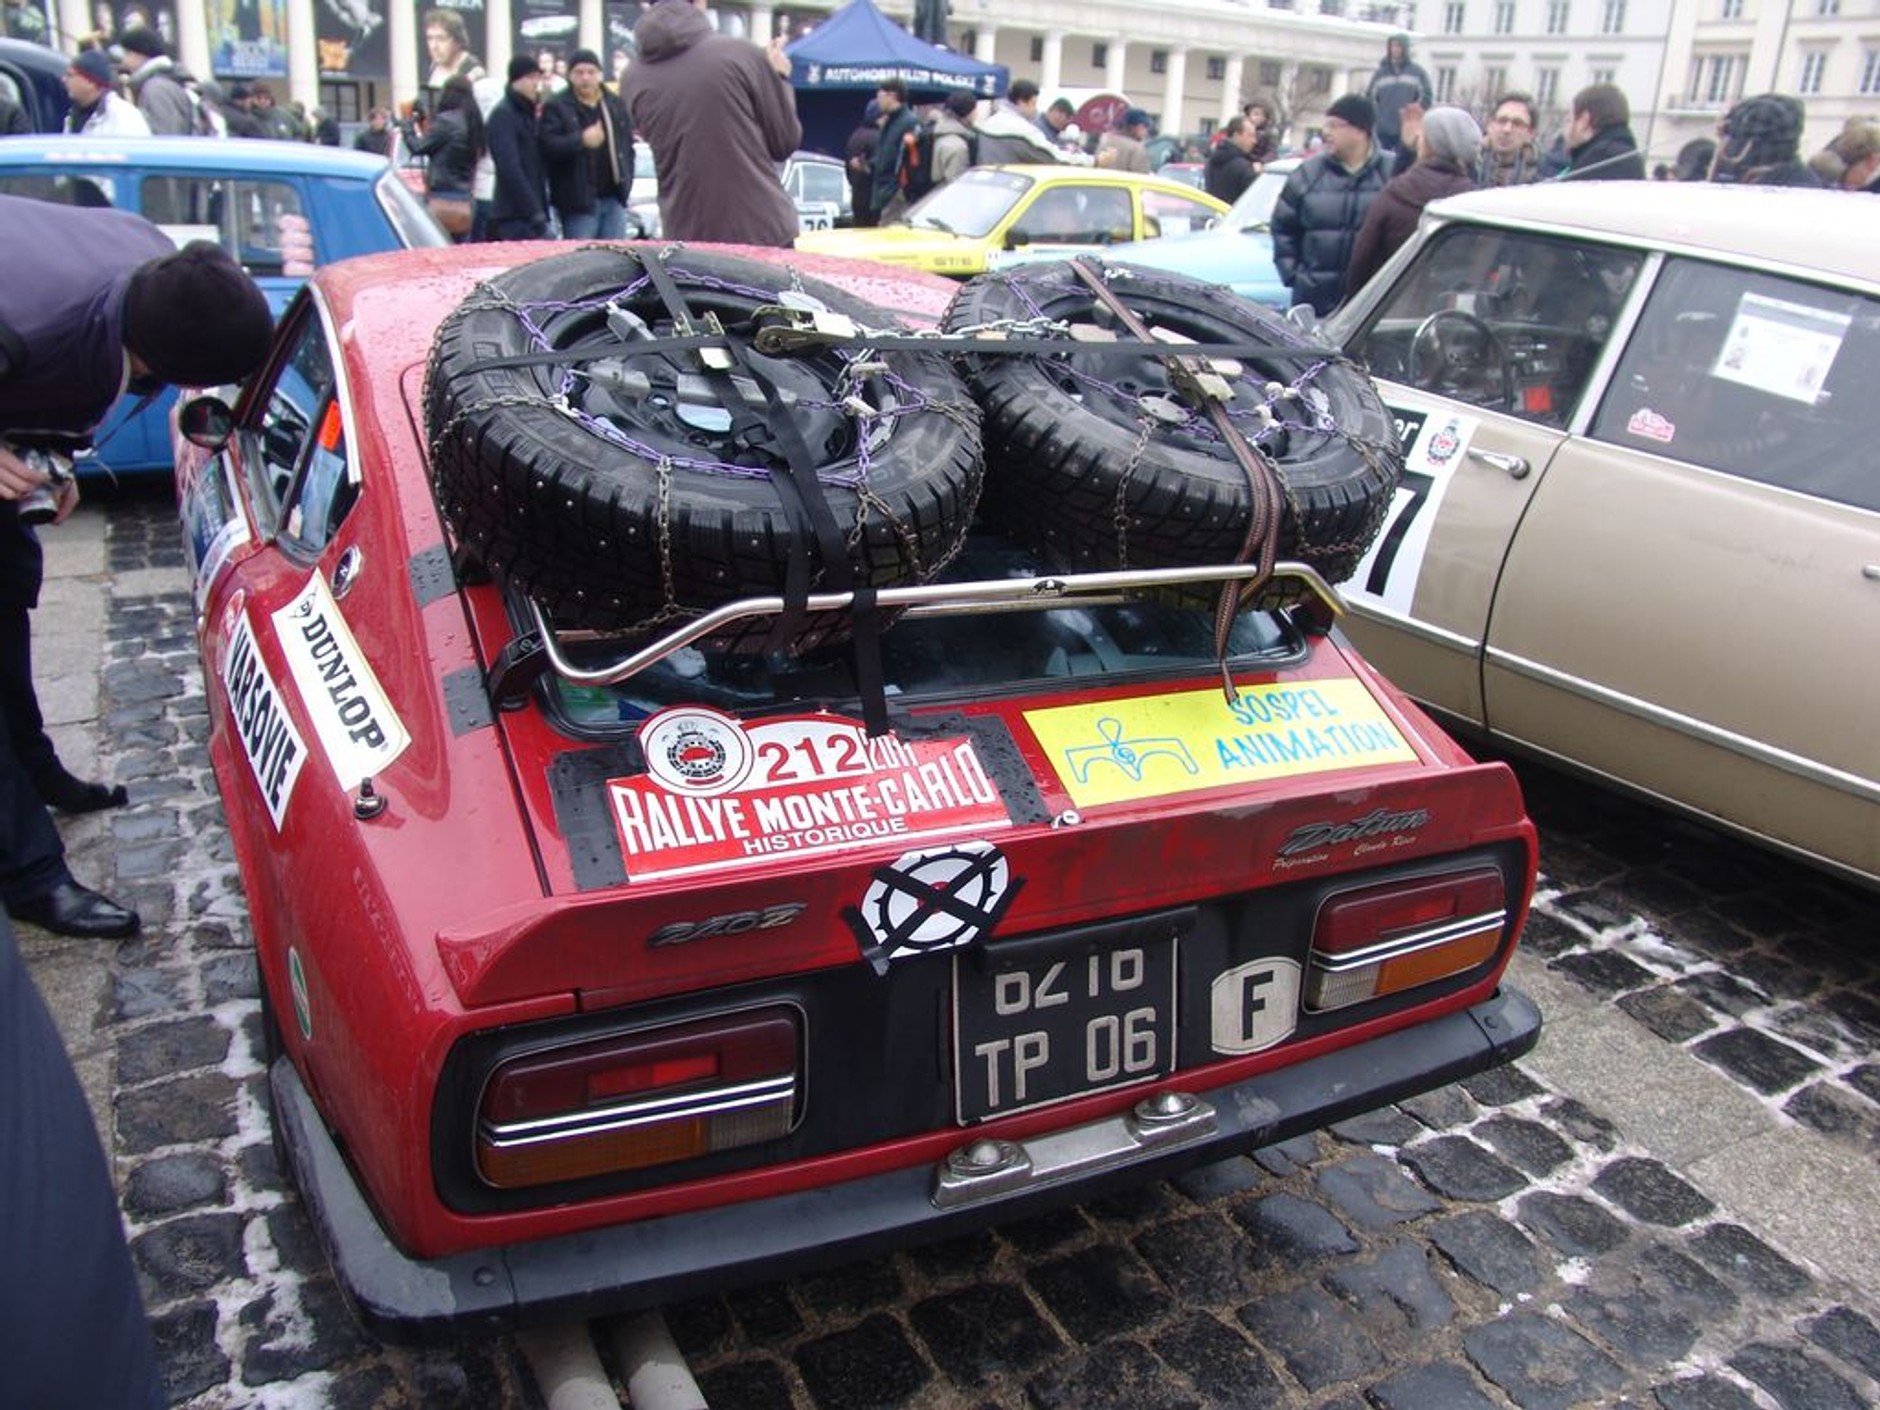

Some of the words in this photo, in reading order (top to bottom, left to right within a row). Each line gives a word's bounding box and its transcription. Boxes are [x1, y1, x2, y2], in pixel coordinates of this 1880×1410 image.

[302, 613, 386, 749] DUNLOP
[1229, 688, 1338, 725] SOSPEL
[226, 621, 298, 813] VARSOVIE
[1215, 720, 1400, 770] ANIMATION
[757, 733, 867, 783] 212
[610, 785, 750, 855] RALLYE
[751, 745, 997, 835] MONTE-CARLO
[743, 817, 909, 856] HISTORIQUE
[1279, 808, 1428, 855] Datsun
[1241, 970, 1274, 1042] F
[974, 1030, 1050, 1108] TP
[1086, 1006, 1157, 1082] 06
